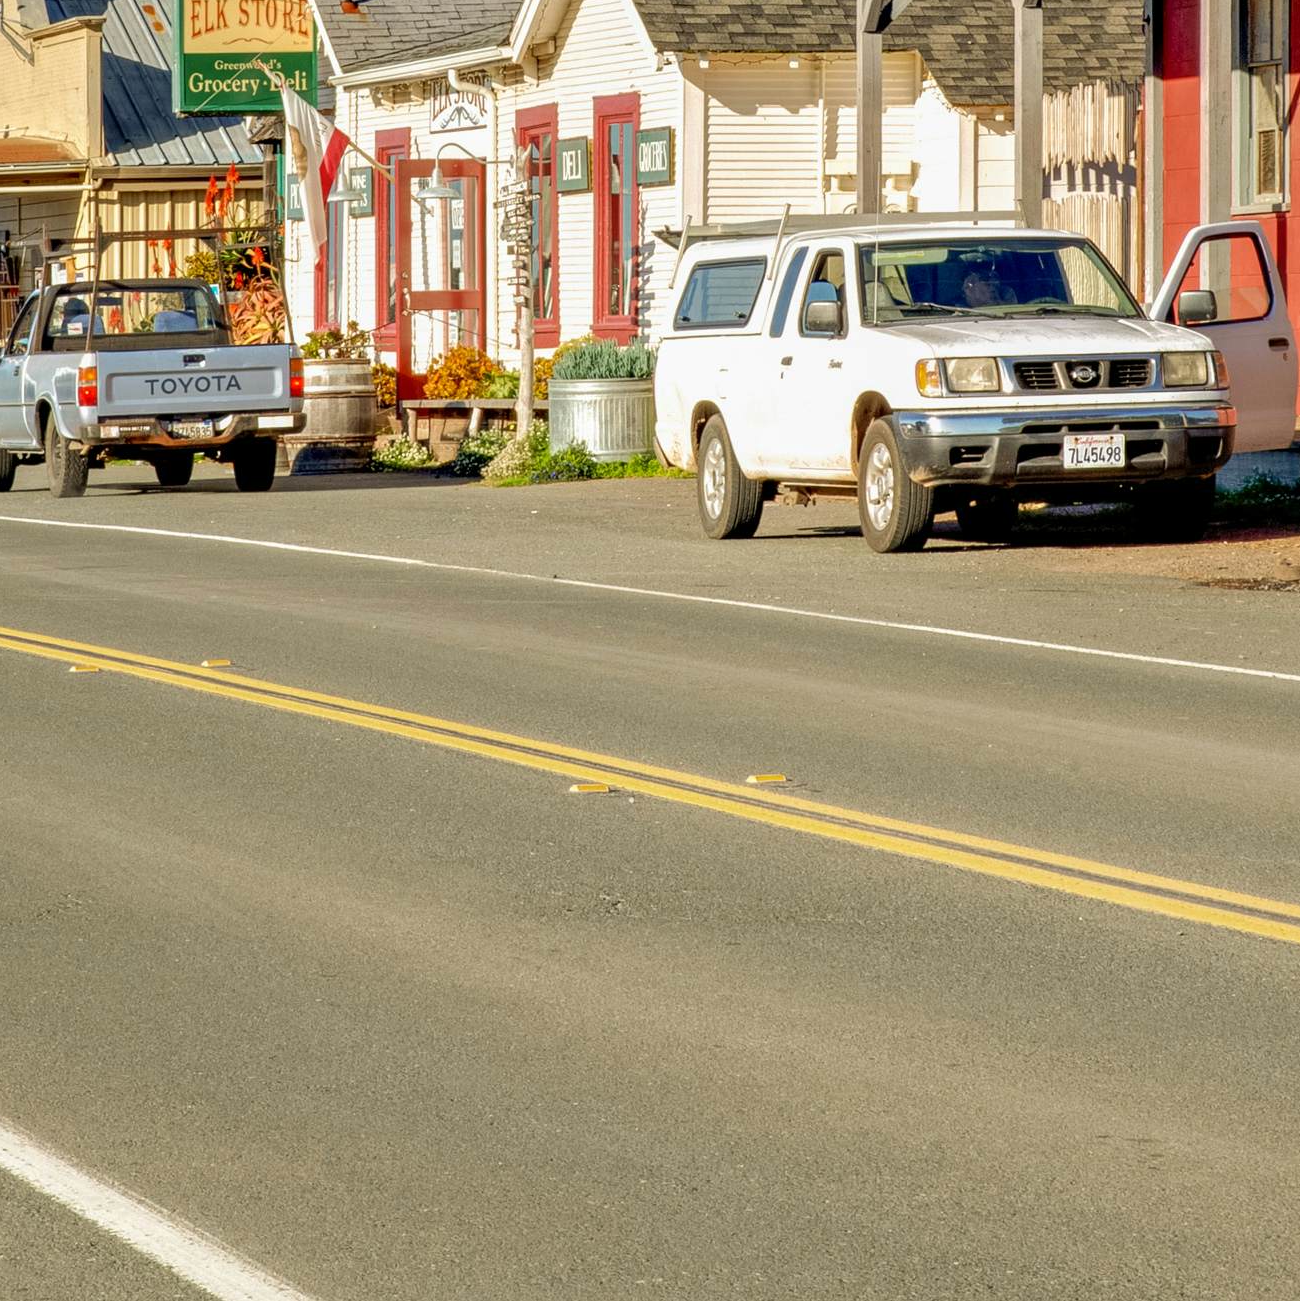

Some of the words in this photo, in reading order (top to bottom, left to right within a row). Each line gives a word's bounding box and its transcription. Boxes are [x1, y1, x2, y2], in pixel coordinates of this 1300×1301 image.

[188, 71, 261, 96] Grocery
[270, 70, 308, 91] Deli
[562, 149, 582, 181] DELI
[639, 140, 668, 173] GROCERIES
[145, 374, 242, 396] TOYOTA
[1068, 446, 1121, 464] 7L45498
